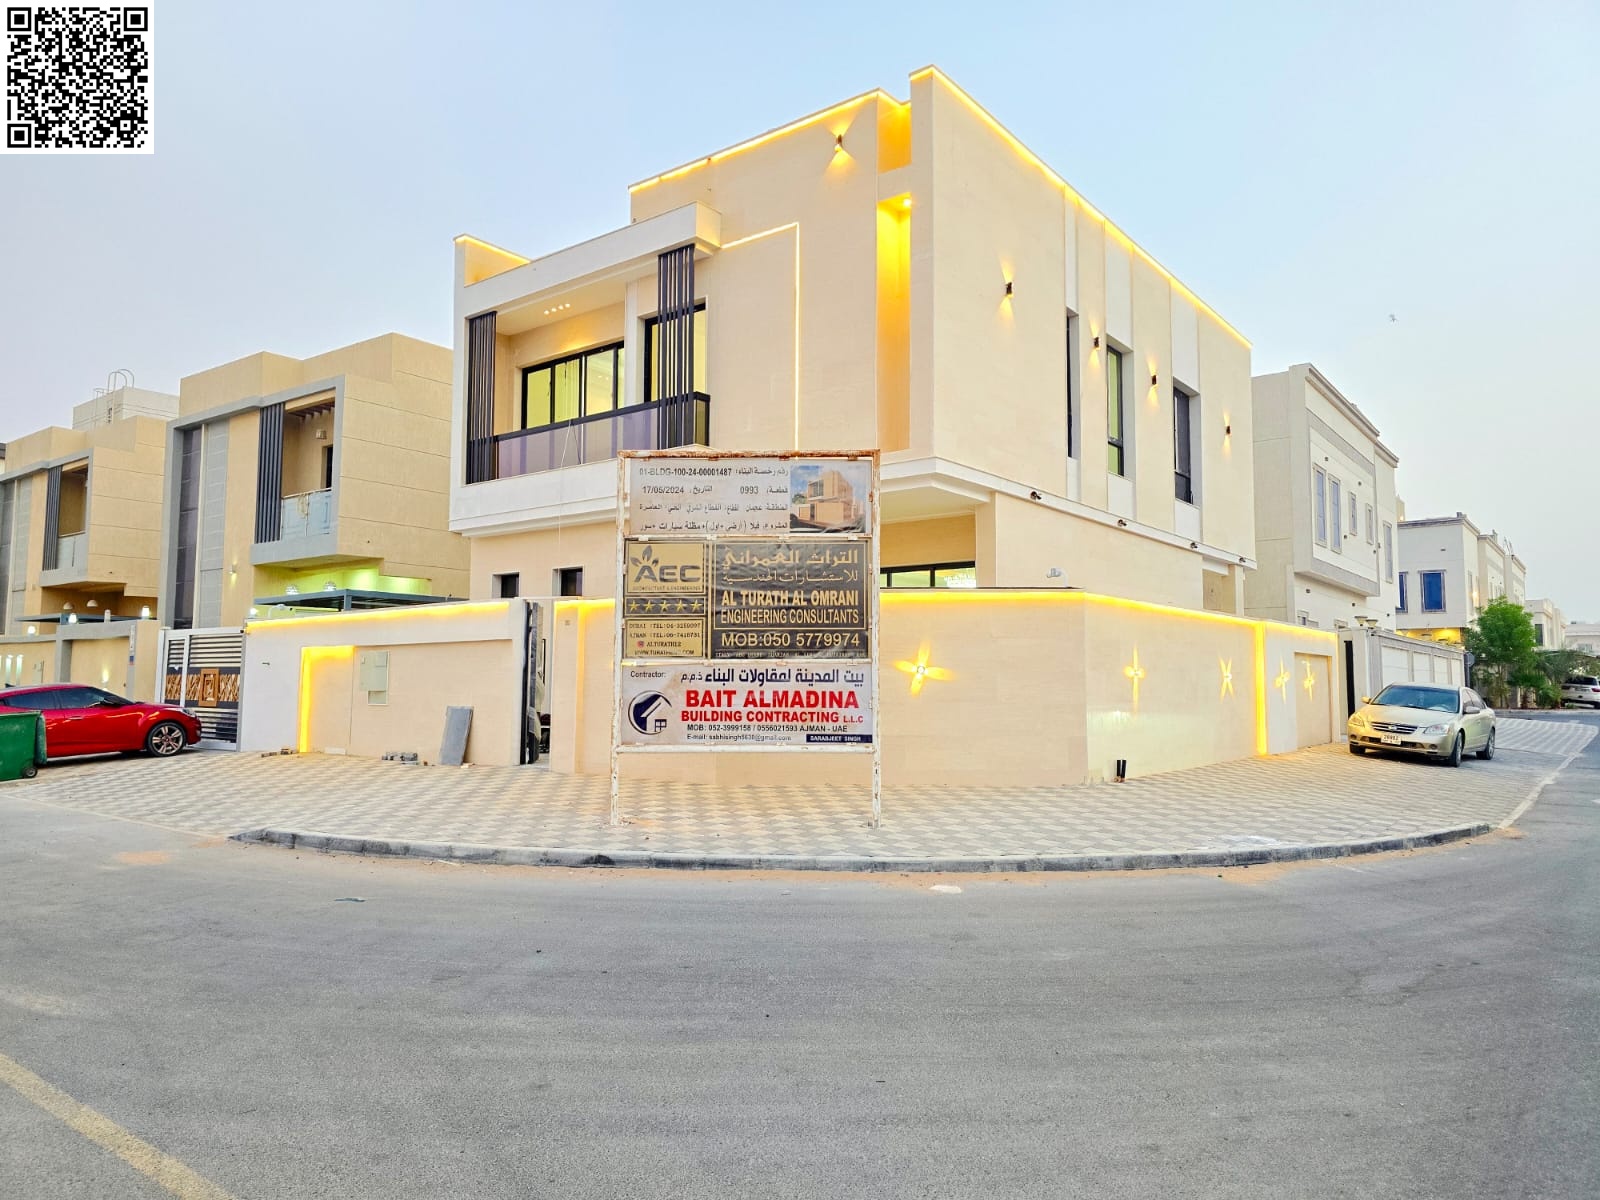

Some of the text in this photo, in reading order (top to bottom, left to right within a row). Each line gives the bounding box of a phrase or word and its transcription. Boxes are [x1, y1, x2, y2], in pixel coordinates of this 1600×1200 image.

[740, 485, 759, 495] 0993
[722, 548, 858, 568] التراث العمراني
[634, 564, 702, 583] AEC
[722, 569, 778, 583] الهندسية
[722, 590, 859, 607] AL TURATH AL OMRANI
[721, 608, 859, 625] ENGINEERING CONSULTANTS
[721, 632, 861, 648] MOB:050 5779974
[630, 670, 667, 679] Contractor:
[704, 668, 735, 683] البناء
[738, 668, 791, 686] لمقاولات
[795, 668, 840, 687] المدينة
[844, 669, 864, 687] بيت
[685, 689, 859, 709] BAIT ALMADINA
[681, 710, 864, 724] BUILDING CONTRACTING L.L.C
[687, 724, 706, 732] MOB:
[756, 724, 798, 733] 0556021593
[799, 724, 826, 734] AJMAN
[832, 724, 848, 734] UAE
